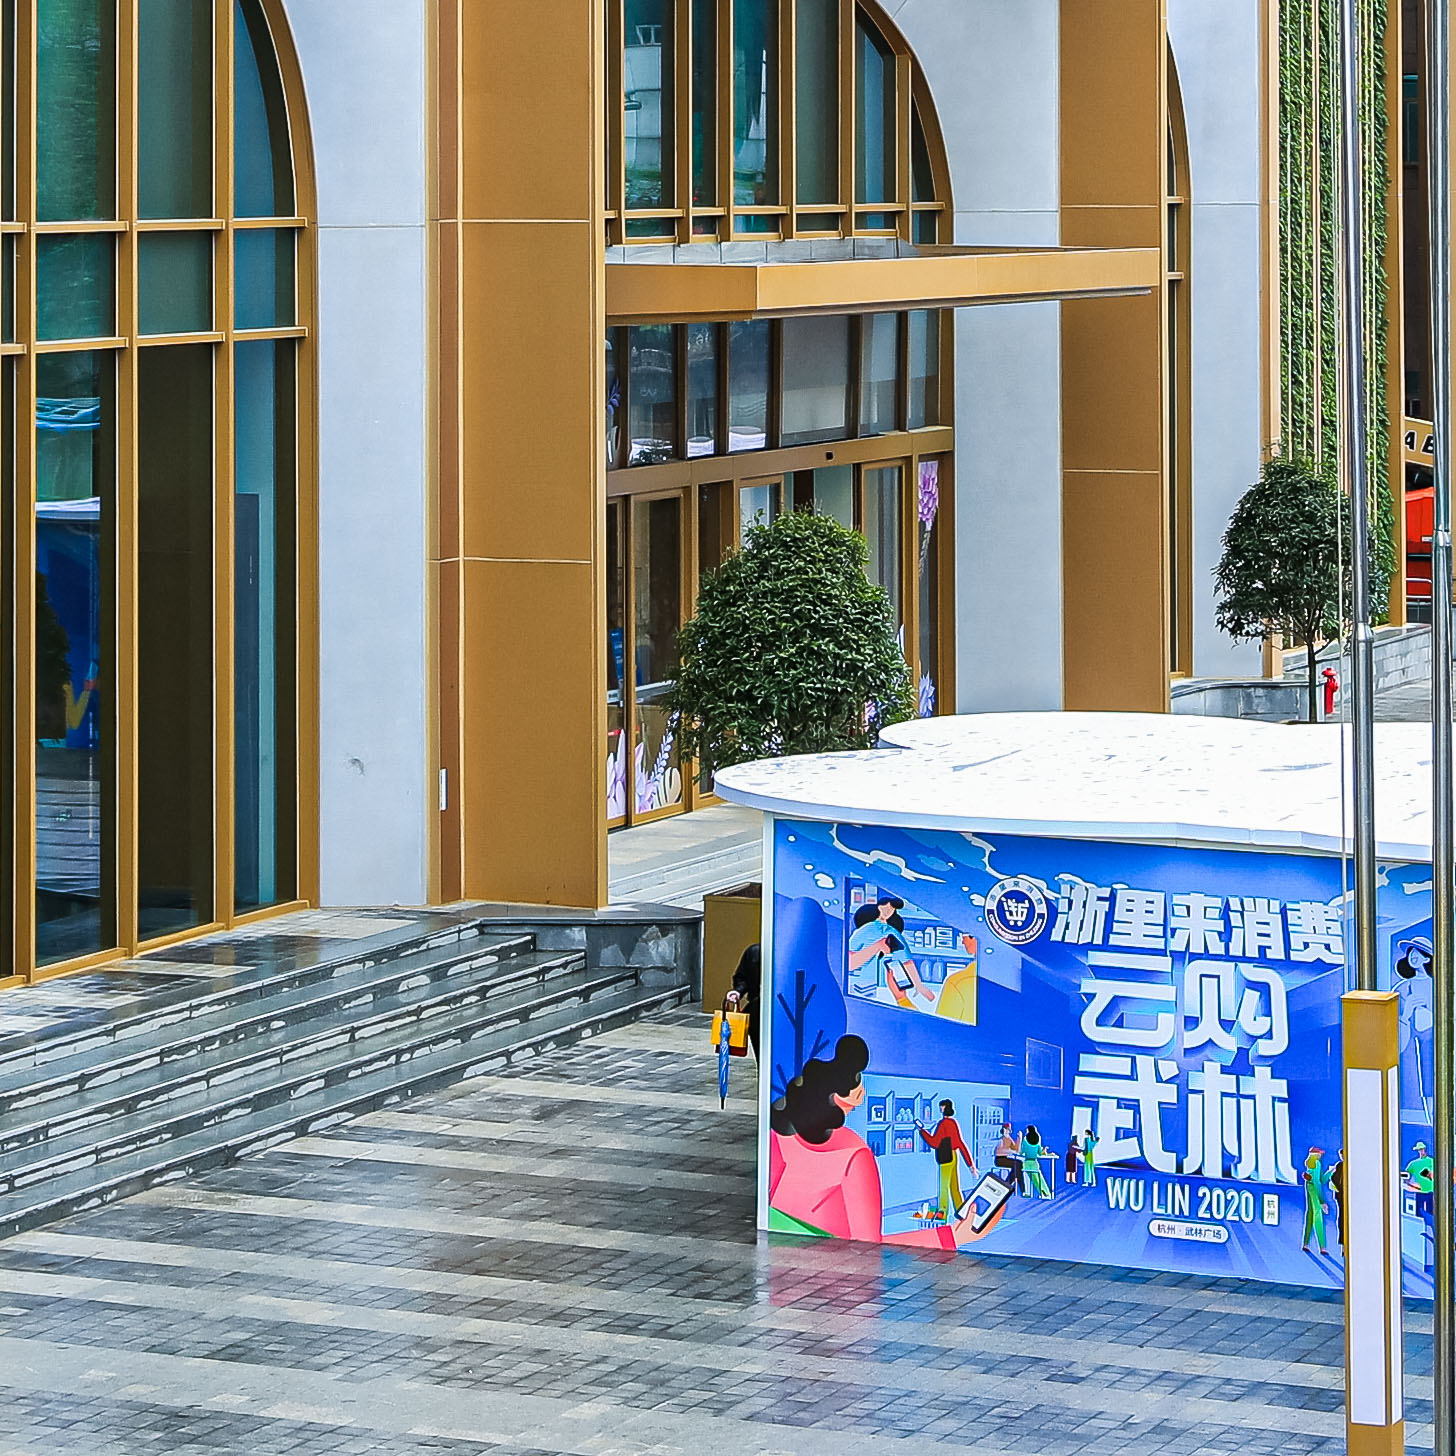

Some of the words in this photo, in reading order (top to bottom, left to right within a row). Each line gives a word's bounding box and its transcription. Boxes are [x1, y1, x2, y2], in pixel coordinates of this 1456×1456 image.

[1051, 882, 1345, 965] 浙里来消费
[1079, 949, 1291, 1057] 云购
[1070, 1053, 1299, 1185] 武林
[1106, 1176, 1144, 1212] WU
[1152, 1180, 1190, 1217] LIN
[1197, 1185, 1255, 1223] 2020
